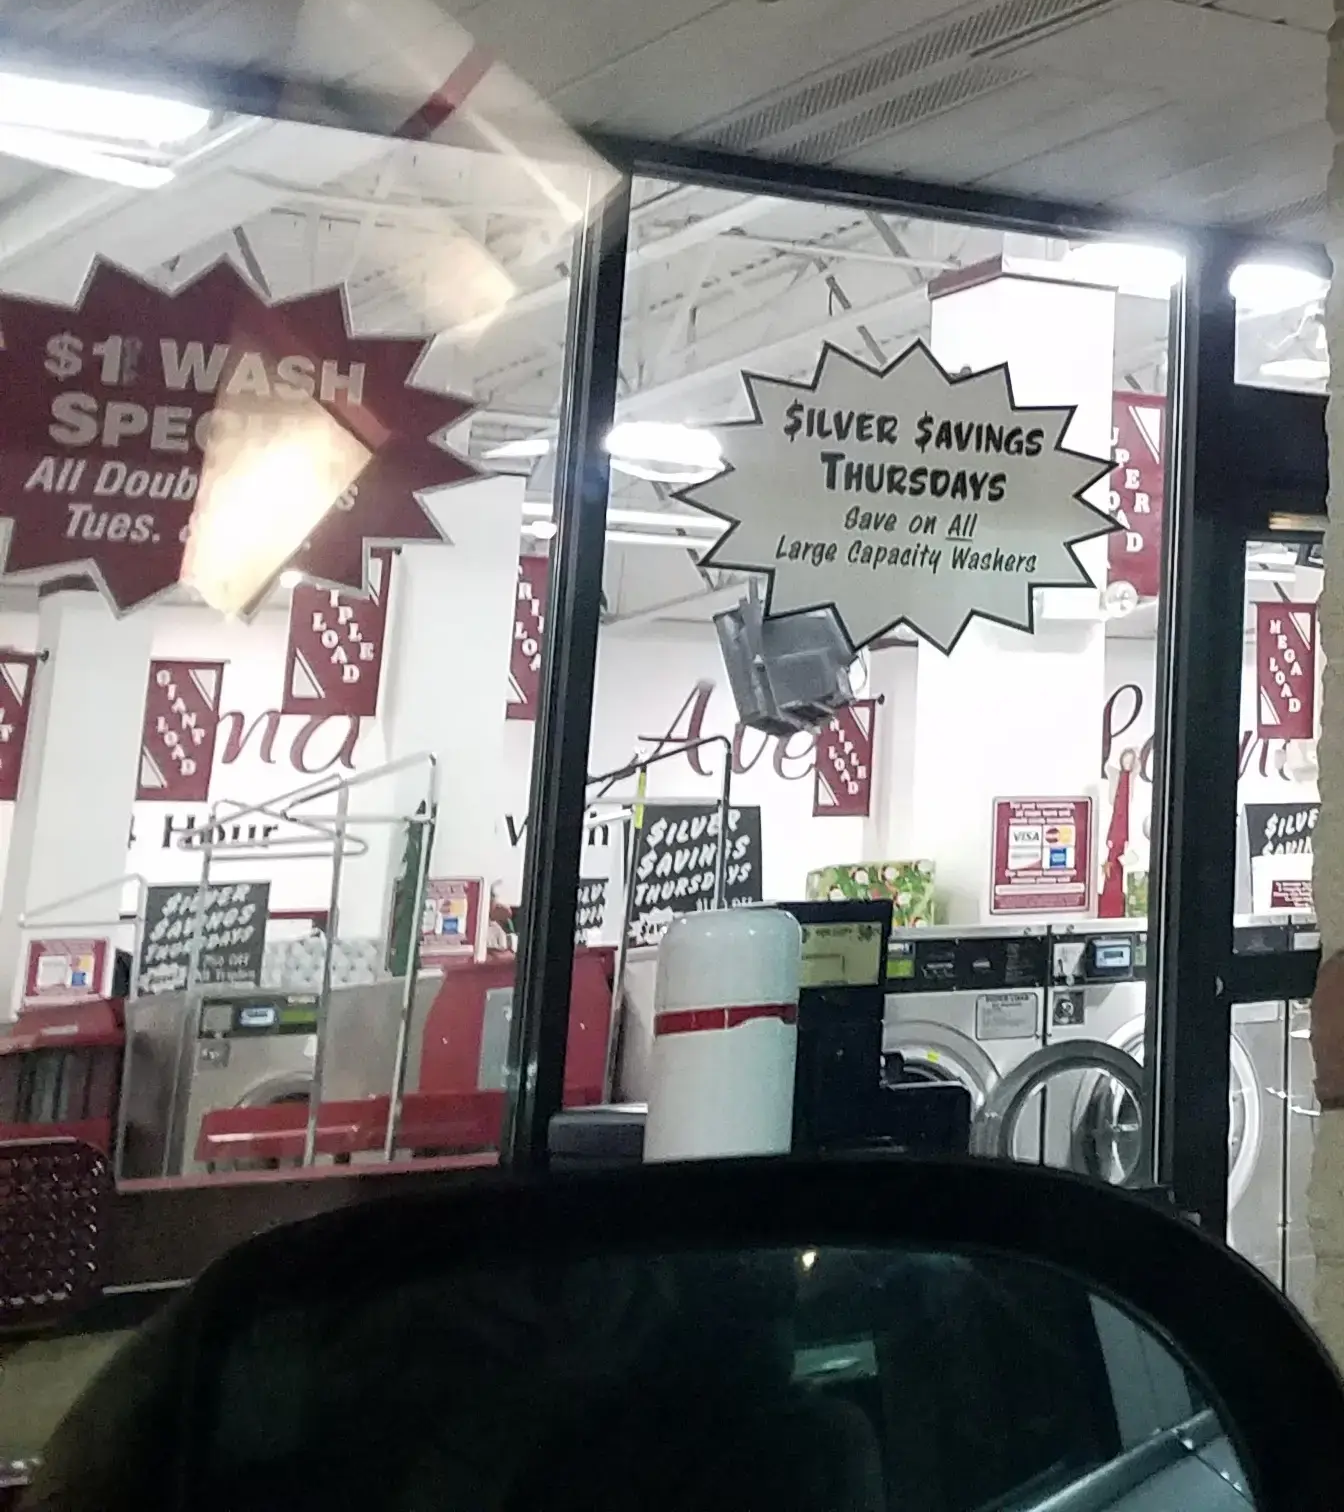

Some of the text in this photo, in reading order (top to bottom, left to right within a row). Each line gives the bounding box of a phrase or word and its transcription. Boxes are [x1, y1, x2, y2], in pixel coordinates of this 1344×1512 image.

[159, 337, 366, 406] WASH
[25, 455, 200, 502] All Doub
[64, 502, 162, 544] Tues.
[844, 505, 979, 540] Save on All
[775, 534, 1039, 574] Large Capacity Washers
[312, 612, 361, 683] LOAD
[329, 589, 375, 661] IPLE
[514, 621, 543, 672] LOA
[1269, 660, 1302, 713] LOAD
[156, 716, 197, 776] LOAD
[1014, 831, 1040, 843] VISA
